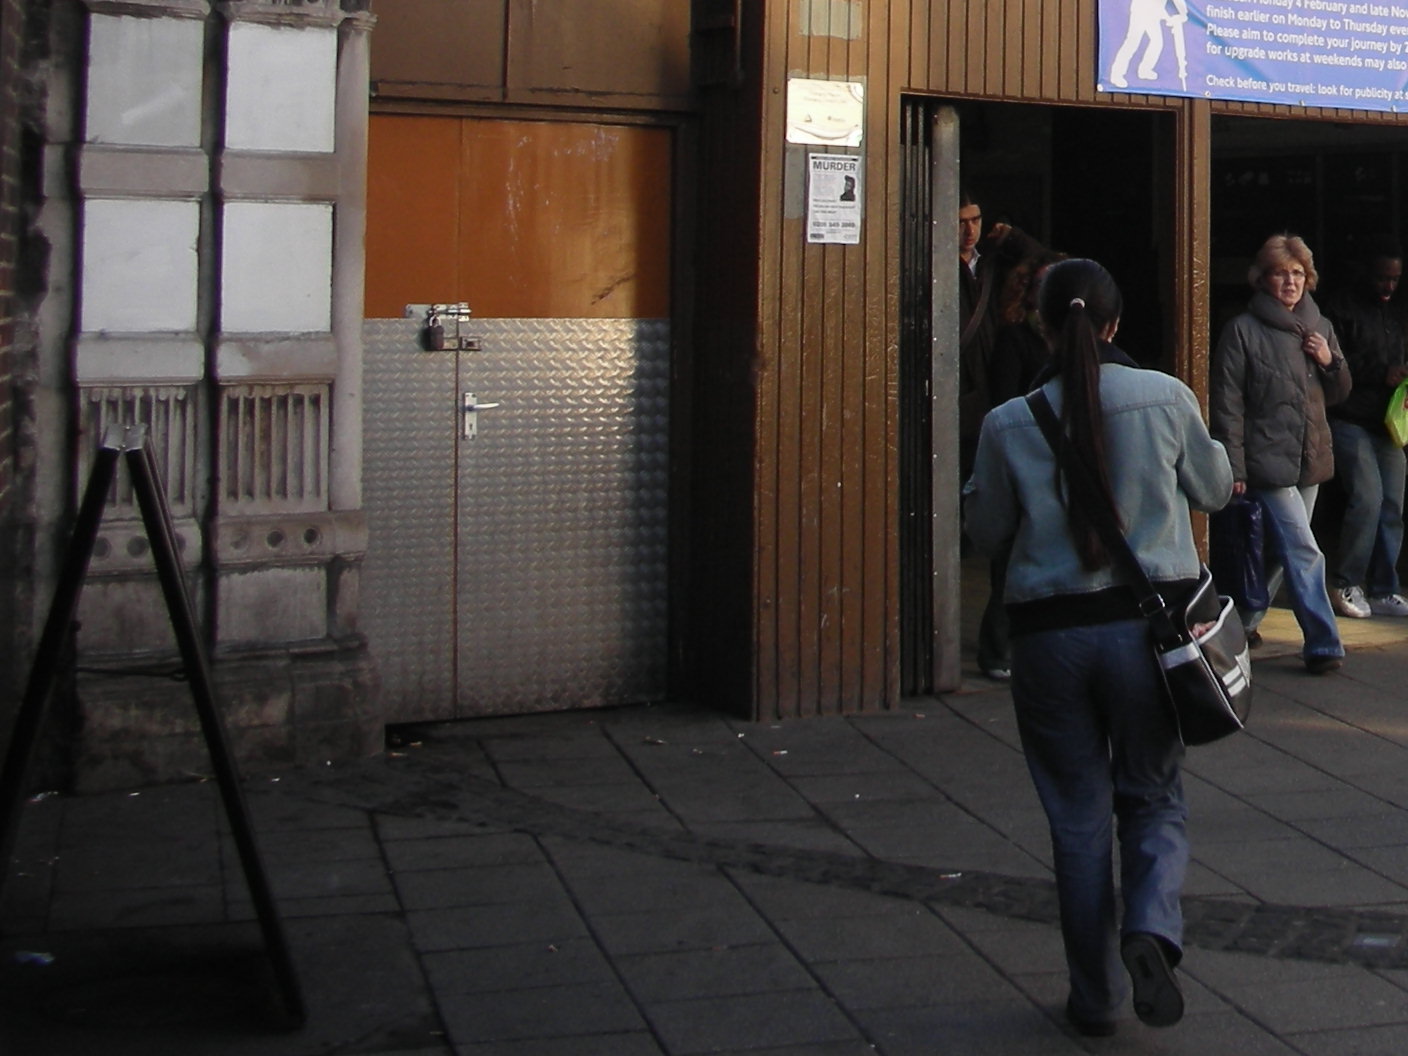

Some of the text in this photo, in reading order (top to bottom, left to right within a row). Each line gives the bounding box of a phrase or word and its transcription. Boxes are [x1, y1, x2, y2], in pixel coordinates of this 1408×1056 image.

[1206, 5, 1235, 20] finish
[1237, 9, 1269, 23] earlier
[1272, 14, 1285, 25] on
[1288, 14, 1327, 31] Monday
[1329, 18, 1340, 30] to
[1343, 19, 1387, 36] Thursday
[1350, 2, 1367, 14] and
[1370, 3, 1389, 17] late
[1206, 23, 1239, 39] Please
[1241, 27, 1260, 40] aim
[1263, 31, 1274, 42] to
[1277, 32, 1325, 48] complete
[1327, 38, 1349, 50] your
[1350, 38, 1387, 54] journey
[1390, 41, 1401, 55] by
[1206, 42, 1222, 55] for
[1225, 45, 1265, 60] upgrade
[1268, 47, 1298, 62] works
[1300, 51, 1310, 63] at
[1313, 52, 1362, 67] weekends
[1365, 58, 1385, 71] may
[1387, 58, 1407, 71] also
[1206, 74, 1235, 88] Check
[1237, 77, 1267, 90] before
[1269, 82, 1286, 93] you
[1318, 83, 1337, 96] look
[1339, 85, 1353, 96] for
[1355, 86, 1392, 101] publicity
[1394, 89, 1403, 100] at
[813, 161, 856, 171] MURDER
